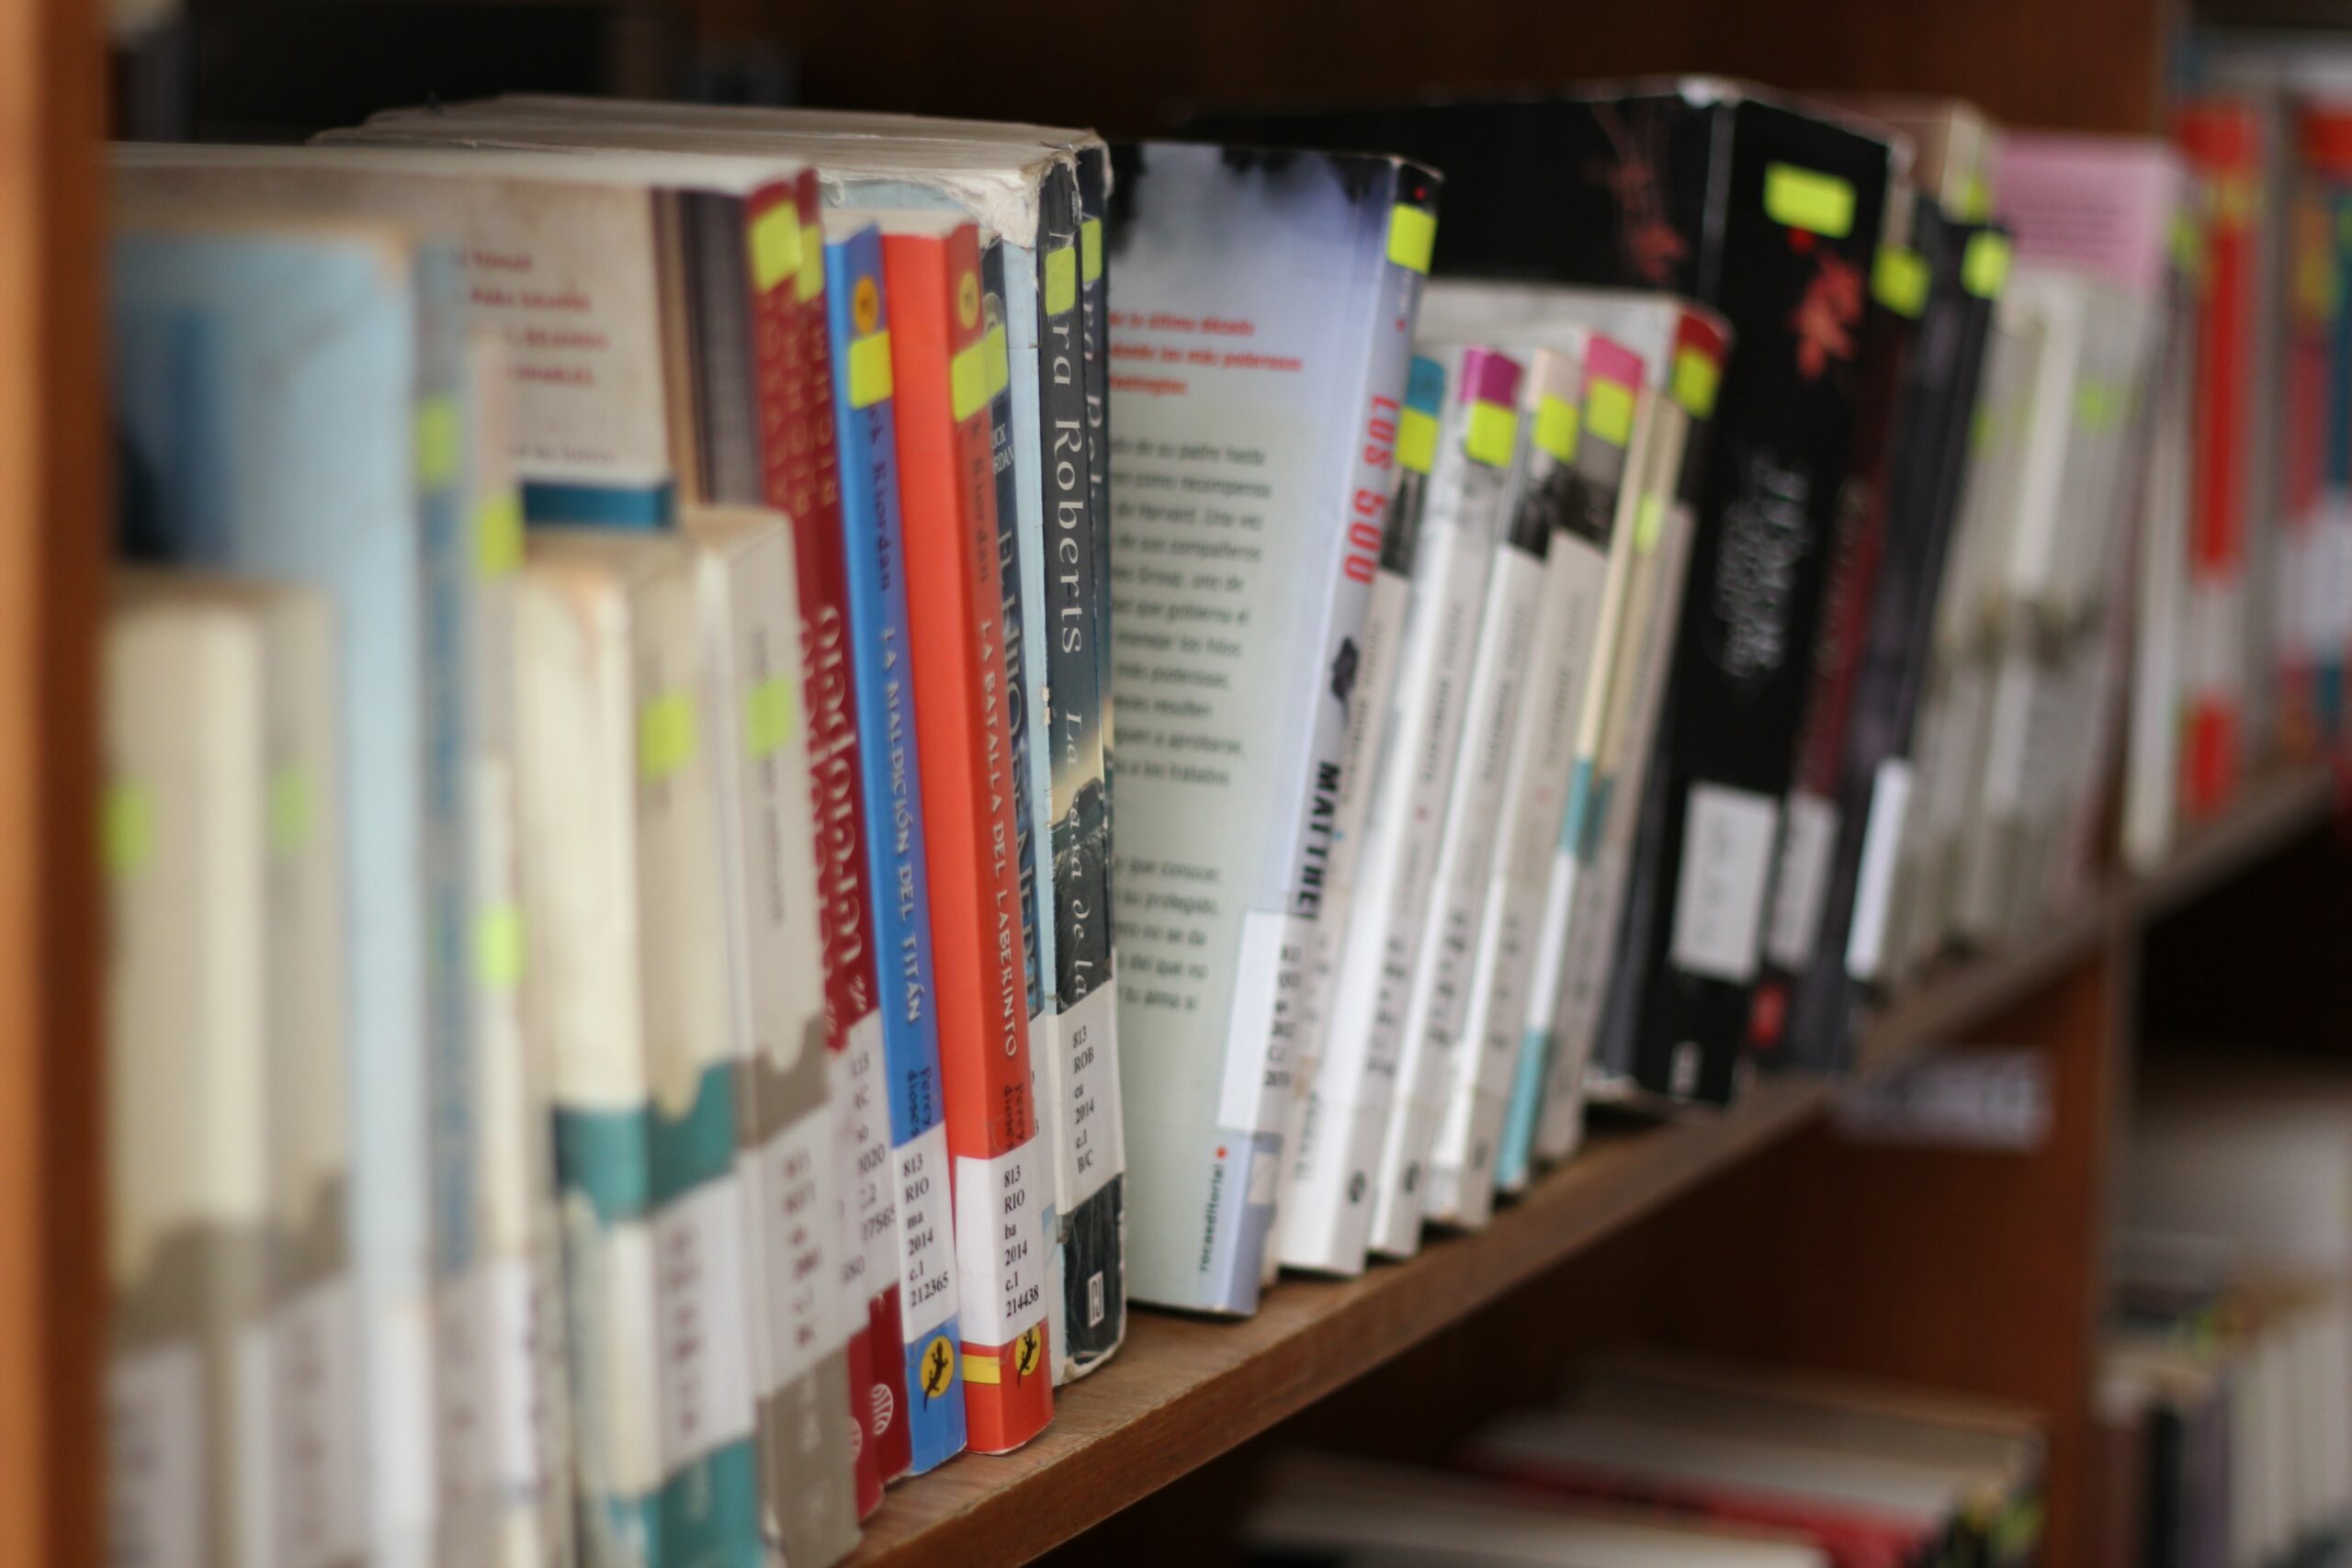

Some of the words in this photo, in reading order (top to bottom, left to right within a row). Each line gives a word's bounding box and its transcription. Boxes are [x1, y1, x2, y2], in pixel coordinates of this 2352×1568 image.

[1363, 394, 1401, 471] LOS
[1054, 419, 1084, 654] Roberts
[1343, 488, 1387, 587] 500
[883, 626, 898, 671] LA
[981, 620, 993, 661] LA
[984, 671, 1002, 814] BATALLA
[1065, 712, 1082, 766] La
[887, 681, 913, 855] MALDICIÓN
[992, 820, 1007, 879] DEL
[1069, 795, 1082, 879] asa
[1296, 759, 1341, 920] MATTHE
[898, 865, 914, 921] DEL
[1072, 897, 1091, 943] de
[903, 931, 925, 1024] TITÁN
[997, 889, 1018, 1057] LABERINTO
[1074, 958, 1093, 998] la
[1073, 1025, 1088, 1049] 813
[1074, 1046, 1095, 1075] ROB
[1075, 1098, 1095, 1125] 2014
[903, 1152, 924, 1178] 813
[1004, 1165, 1022, 1189] 813
[1077, 1148, 1094, 1175] B/C
[905, 1176, 930, 1203] RIO
[1004, 1189, 1025, 1214] RIO
[907, 1211, 924, 1231] ma
[1005, 1224, 1017, 1241] ba
[908, 1227, 934, 1256] 2014
[1005, 1240, 1028, 1267] 2014
[910, 1271, 950, 1308] 212365
[1006, 1285, 1040, 1318] 214438
